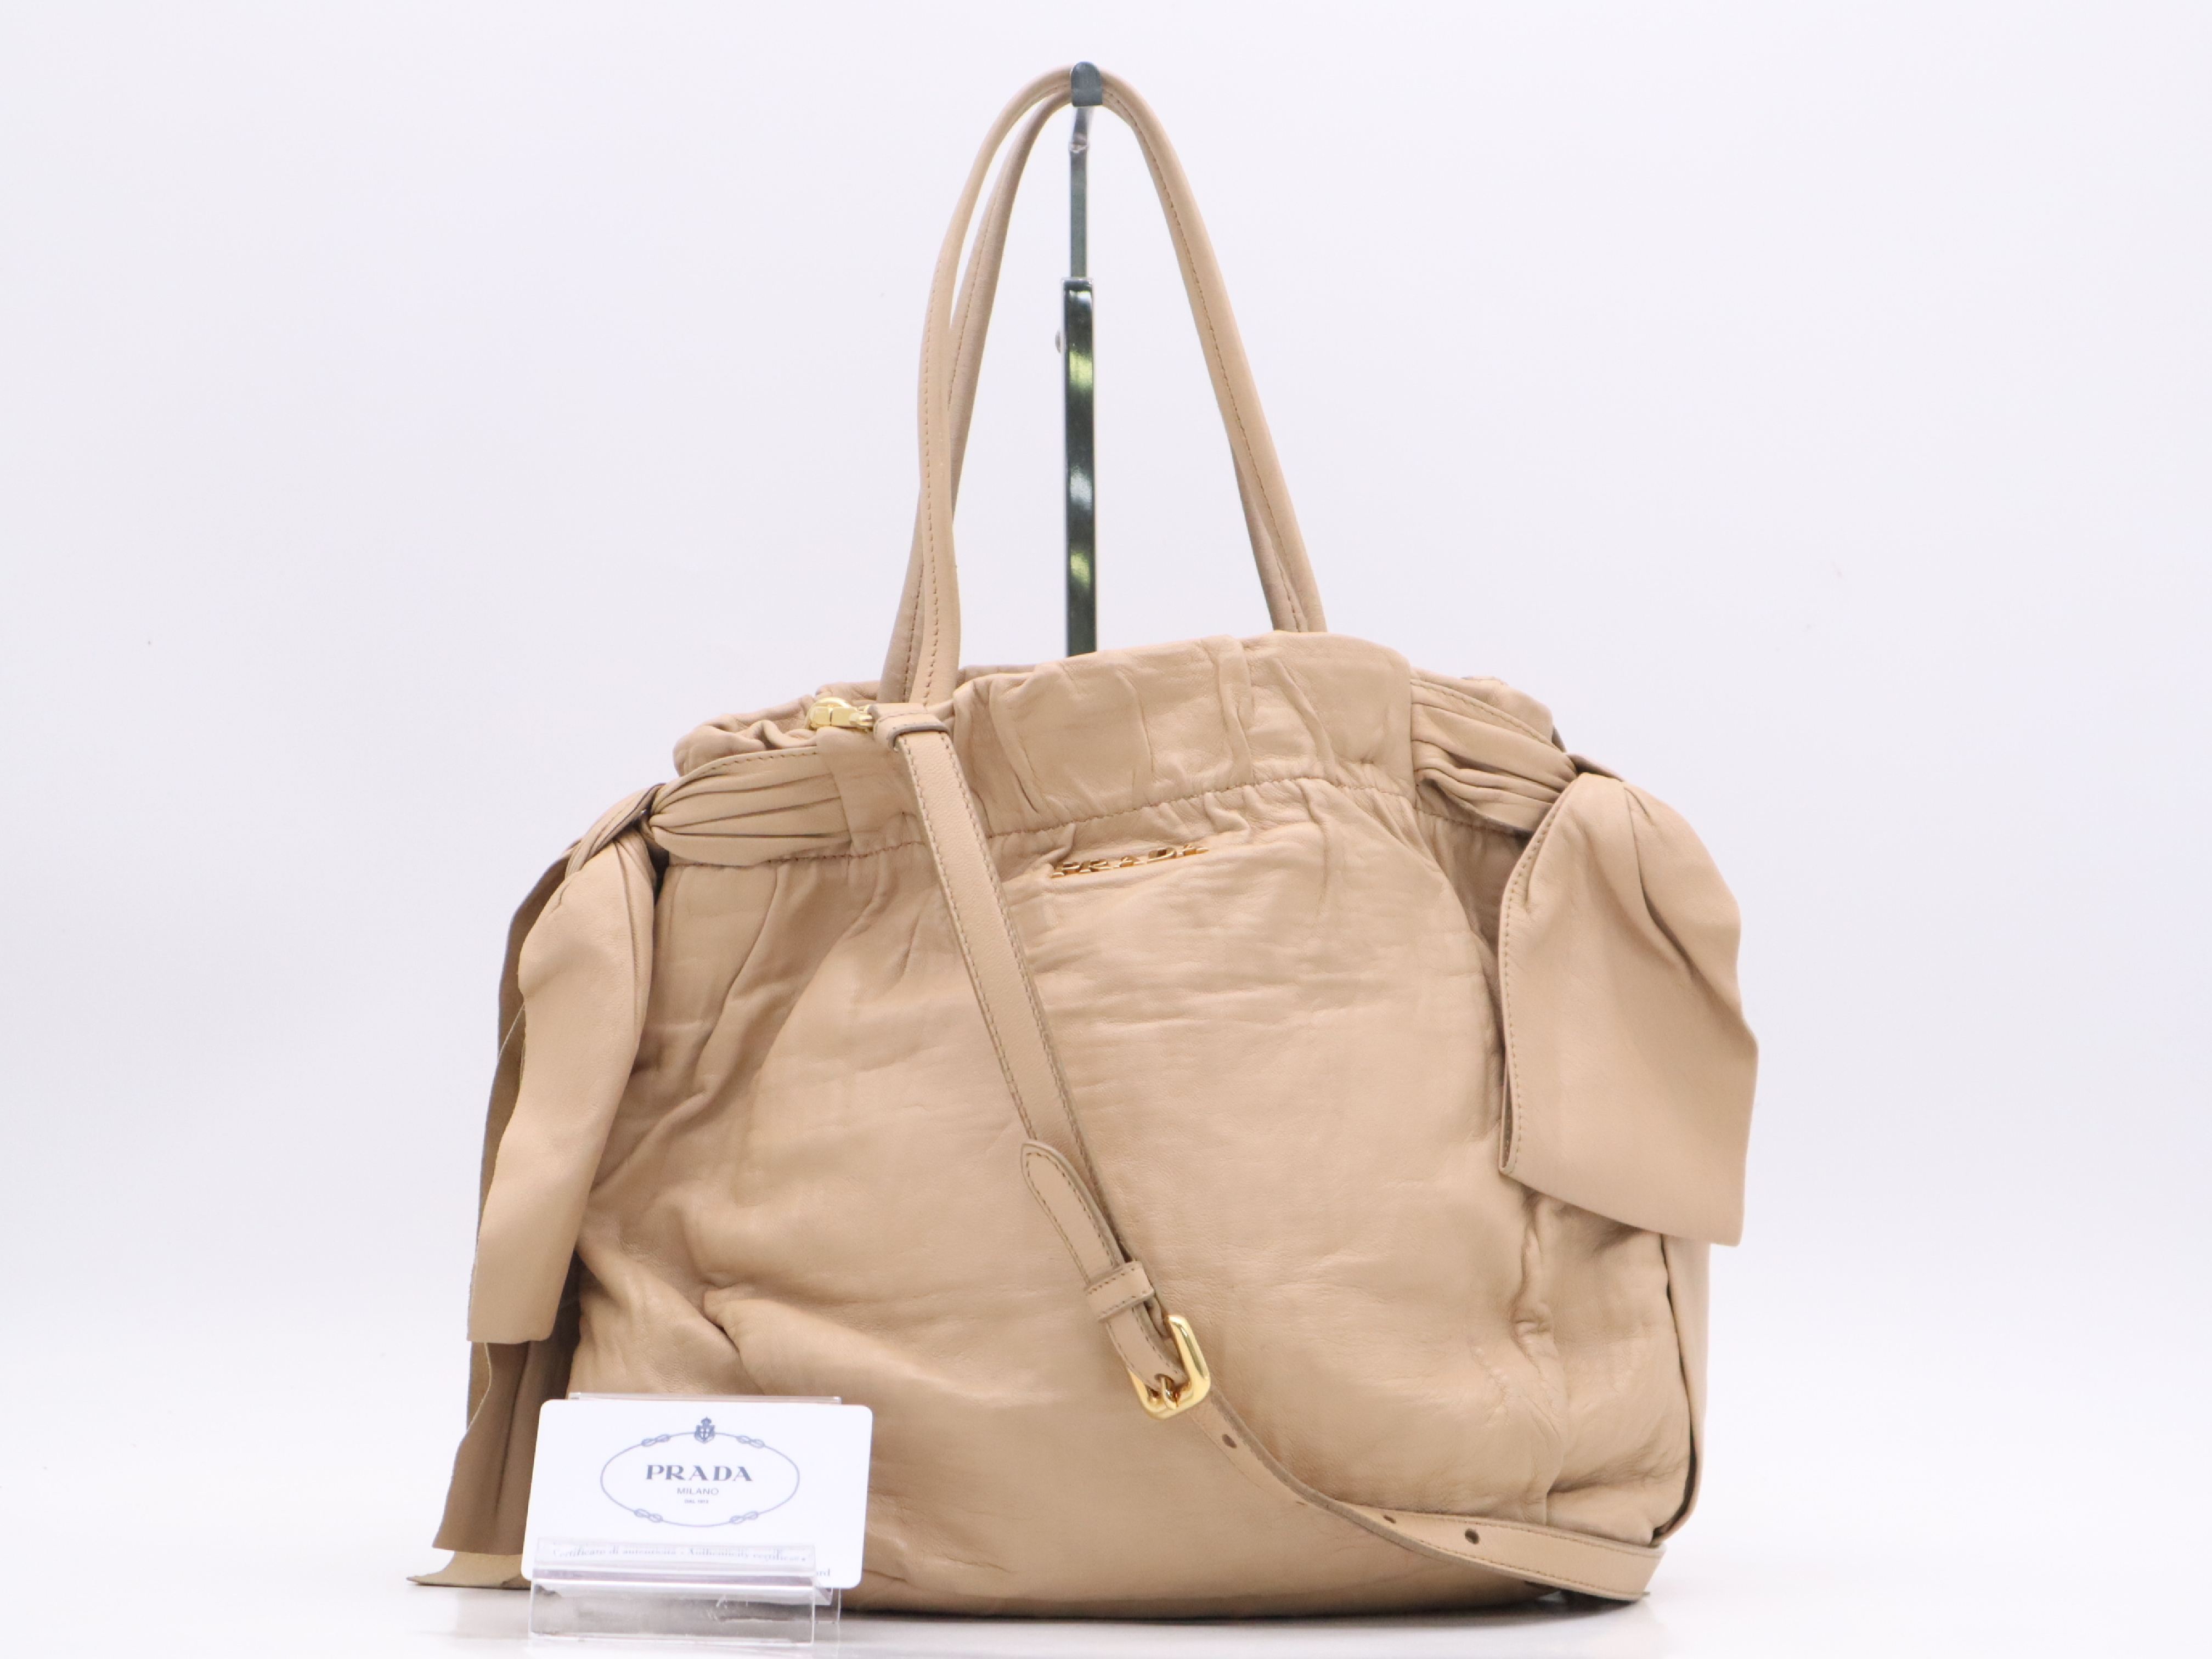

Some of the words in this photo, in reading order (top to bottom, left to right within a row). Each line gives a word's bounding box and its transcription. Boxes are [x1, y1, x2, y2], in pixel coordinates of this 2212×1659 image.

[1051, 843, 1209, 878] PRADA
[646, 1464, 753, 1482] PRADA
[677, 1487, 719, 1496] MILANO
